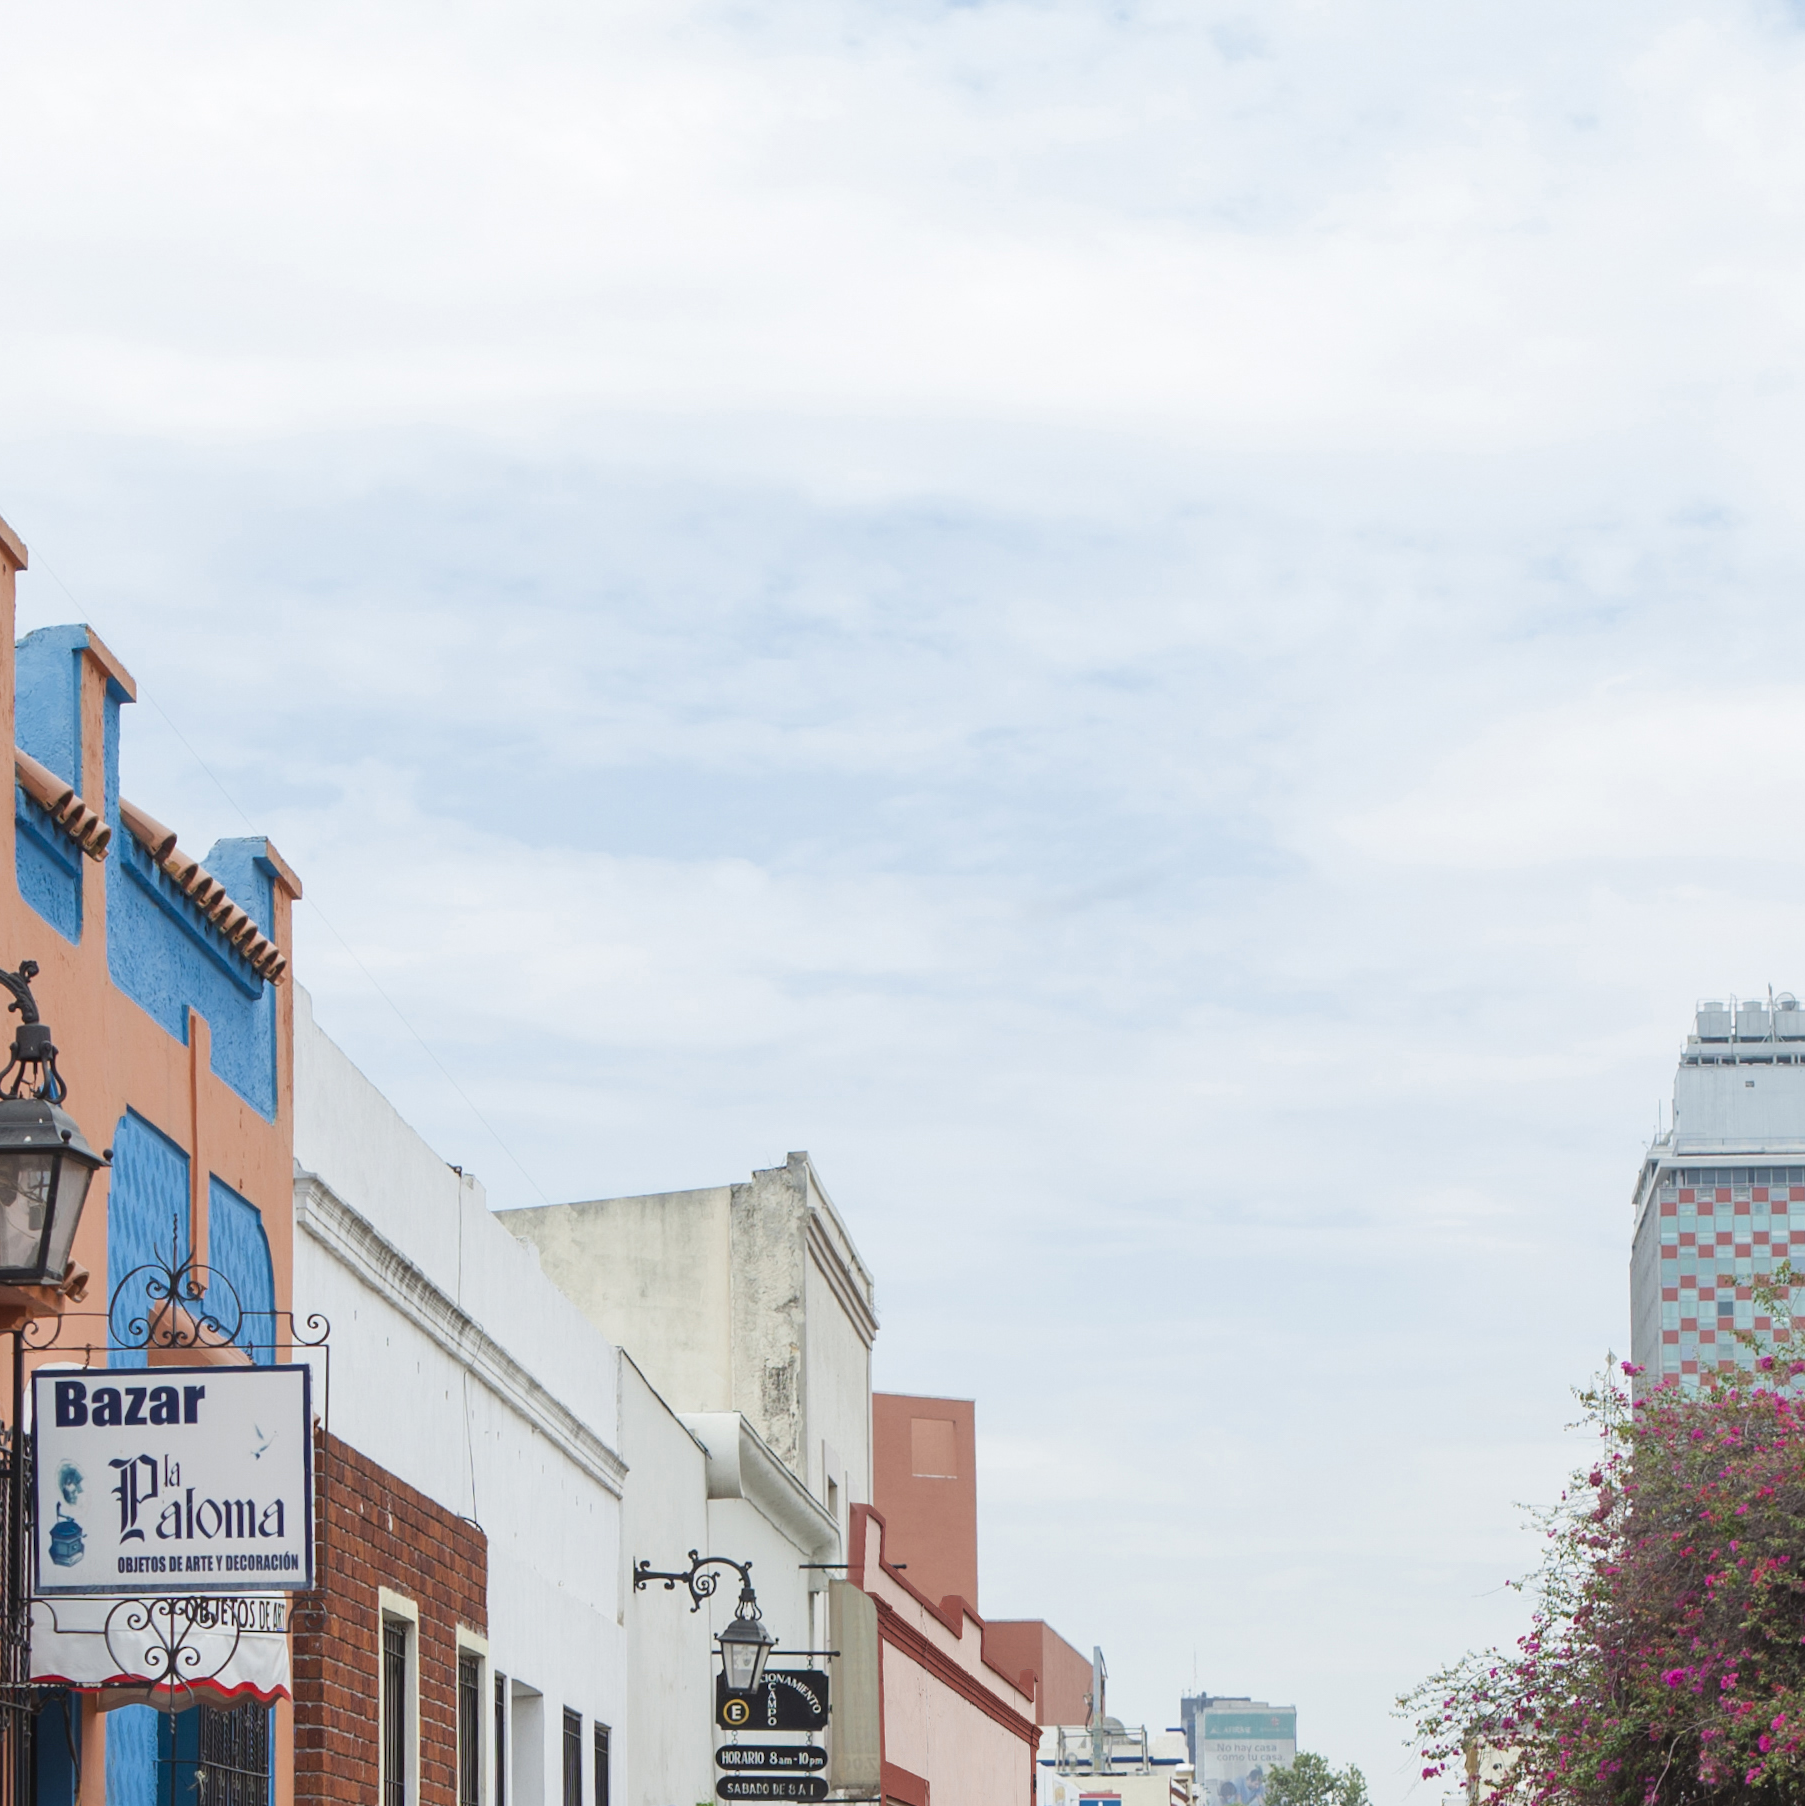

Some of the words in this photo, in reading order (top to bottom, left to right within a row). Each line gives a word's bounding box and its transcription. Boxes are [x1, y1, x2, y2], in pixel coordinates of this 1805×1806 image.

[54, 1381, 206, 1428] Bazar
[163, 1453, 181, 1488] la
[107, 1453, 285, 1546] Paloma
[117, 1556, 167, 1574] OBJETOS
[168, 1555, 183, 1573] DE
[185, 1555, 214, 1572] ARTE
[215, 1555, 224, 1572] Y
[225, 1551, 299, 1572] DECORACIÓN
[185, 1598, 255, 1629] OBJETOS
[259, 1600, 271, 1632] DE
[721, 1751, 765, 1765] HORARIO
[1217, 1744, 1232, 1752] No
[1234, 1744, 1252, 1753] hay
[1254, 1744, 1278, 1752] casa
[727, 1782, 770, 1795] SABADO
[772, 1782, 787, 1796] DE
[788, 1783, 796, 1796] 8
[798, 1784, 807, 1796] A
